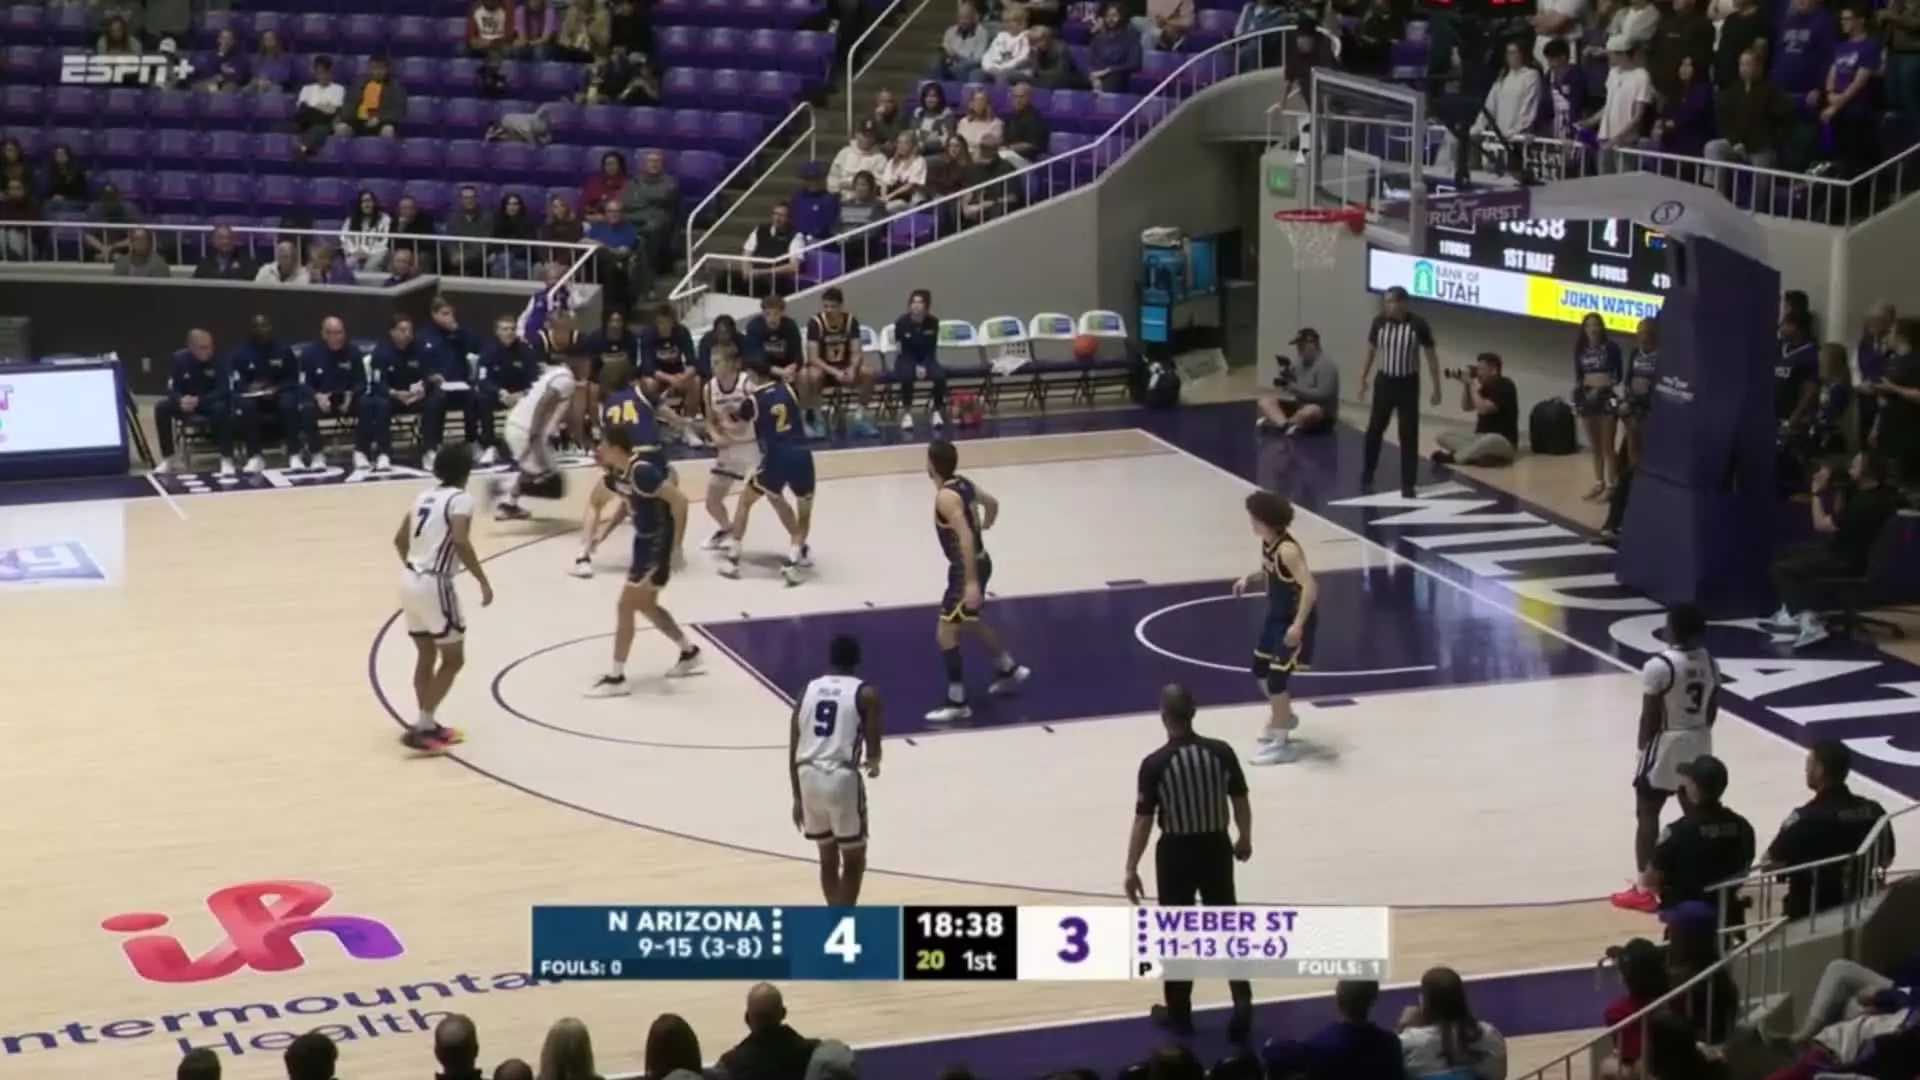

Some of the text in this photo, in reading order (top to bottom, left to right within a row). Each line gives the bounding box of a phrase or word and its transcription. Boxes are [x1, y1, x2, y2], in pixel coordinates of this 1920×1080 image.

[1426, 203, 1524, 226] RICA FIRST
[1602, 217, 1619, 248] 4
[1435, 279, 1480, 305] UTAH
[1560, 289, 1600, 311] JOHN
[770, 402, 792, 433] 2
[414, 507, 431, 539] 7
[1685, 682, 1704, 714] 3
[814, 699, 839, 738] 9
